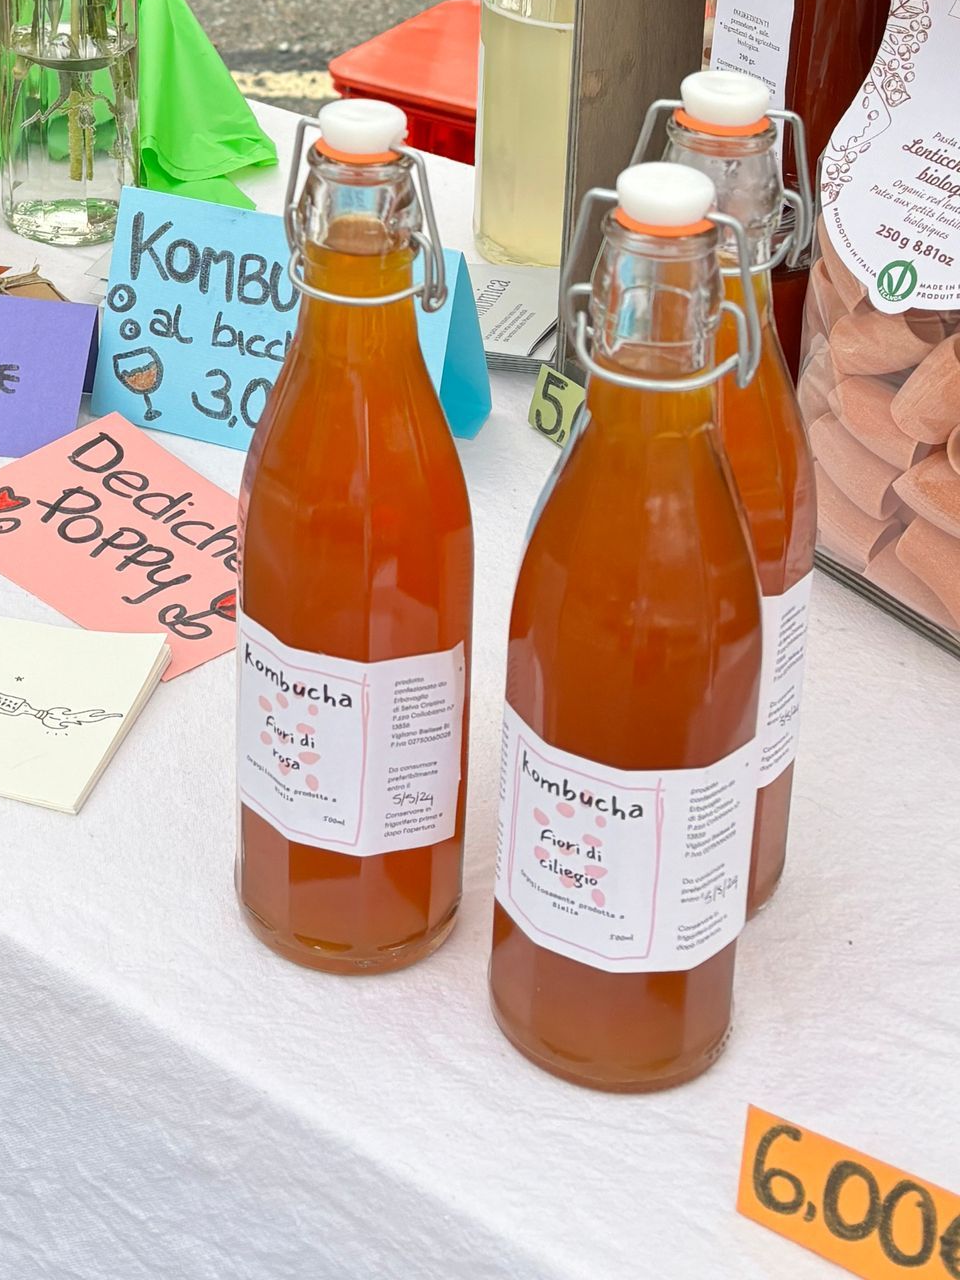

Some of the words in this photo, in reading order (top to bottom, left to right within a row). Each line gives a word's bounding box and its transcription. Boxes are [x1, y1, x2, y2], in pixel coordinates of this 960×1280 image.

[932, 131, 957, 147] Pasta
[892, 179, 927, 200] Organic
[928, 191, 942, 207] red
[893, 196, 915, 208] aux
[910, 203, 936, 219] petits
[903, 213, 950, 241] biologiques
[832, 207, 852, 249] PRODOTTO
[855, 256, 877, 279] ITALIA
[876, 224, 901, 243] 250
[899, 236, 910, 250] g
[912, 240, 955, 267] 8,81oz
[919, 282, 943, 291] MADE
[916, 292, 954, 300] PRODUIT
[149, 304, 193, 344] al
[244, 642, 353, 709] kombucha
[394, 677, 425, 688] prodotto
[393, 693, 429, 705] Erbavoglio
[300, 733, 315, 749] di
[272, 748, 301, 770] rosa
[400, 760, 438, 773] consumare
[387, 769, 438, 784] preferibilmente
[387, 784, 406, 792] entro
[522, 750, 644, 820] kombucha
[323, 815, 345, 826] 500ml
[384, 816, 418, 830] frigorifero
[419, 813, 438, 824] prima
[385, 808, 424, 820] Conservare
[383, 827, 403, 838] dopo
[540, 829, 581, 855] Fiori
[586, 846, 603, 863] di
[539, 858, 599, 889] ciliegio
[552, 902, 579, 917] Biella
[609, 933, 634, 942] 500ml
